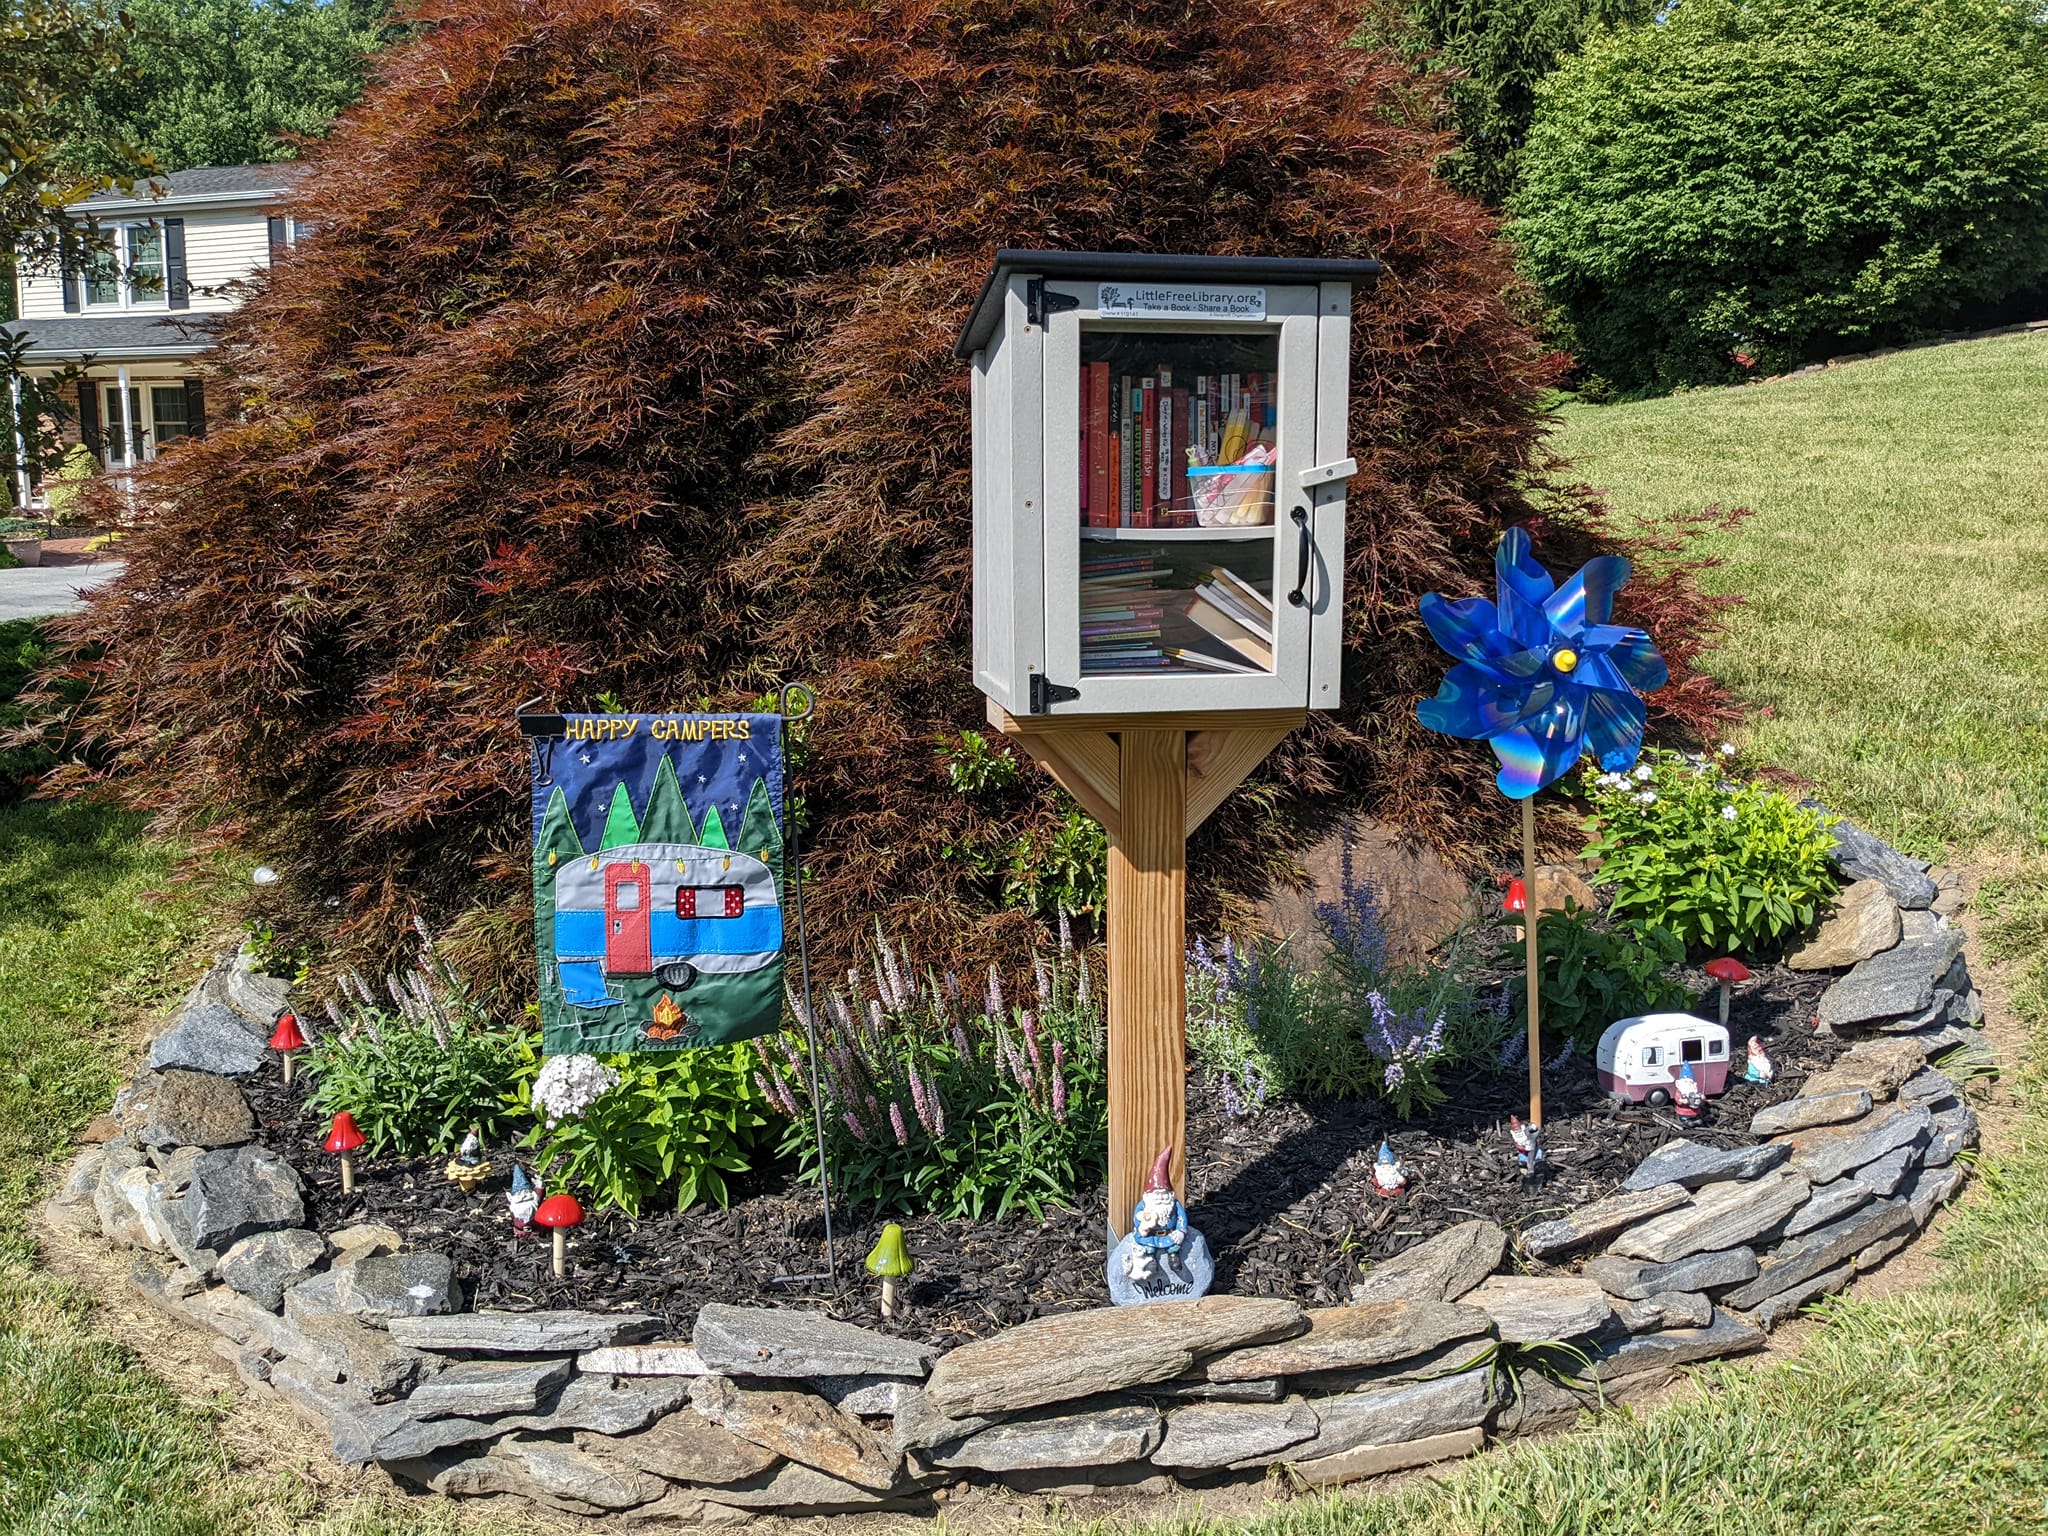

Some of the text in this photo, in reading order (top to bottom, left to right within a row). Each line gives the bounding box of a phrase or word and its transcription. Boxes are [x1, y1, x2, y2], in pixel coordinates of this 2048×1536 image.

[1136, 290, 1257, 305] LittleFreeLibrary.org
[1143, 302, 1162, 311] Take
[1171, 303, 1190, 312] Book
[1198, 303, 1222, 312] Share
[1230, 304, 1250, 313] Book
[566, 719, 751, 741] HAPPY CAMPERS
[1132, 1278, 1194, 1299] Welcome
